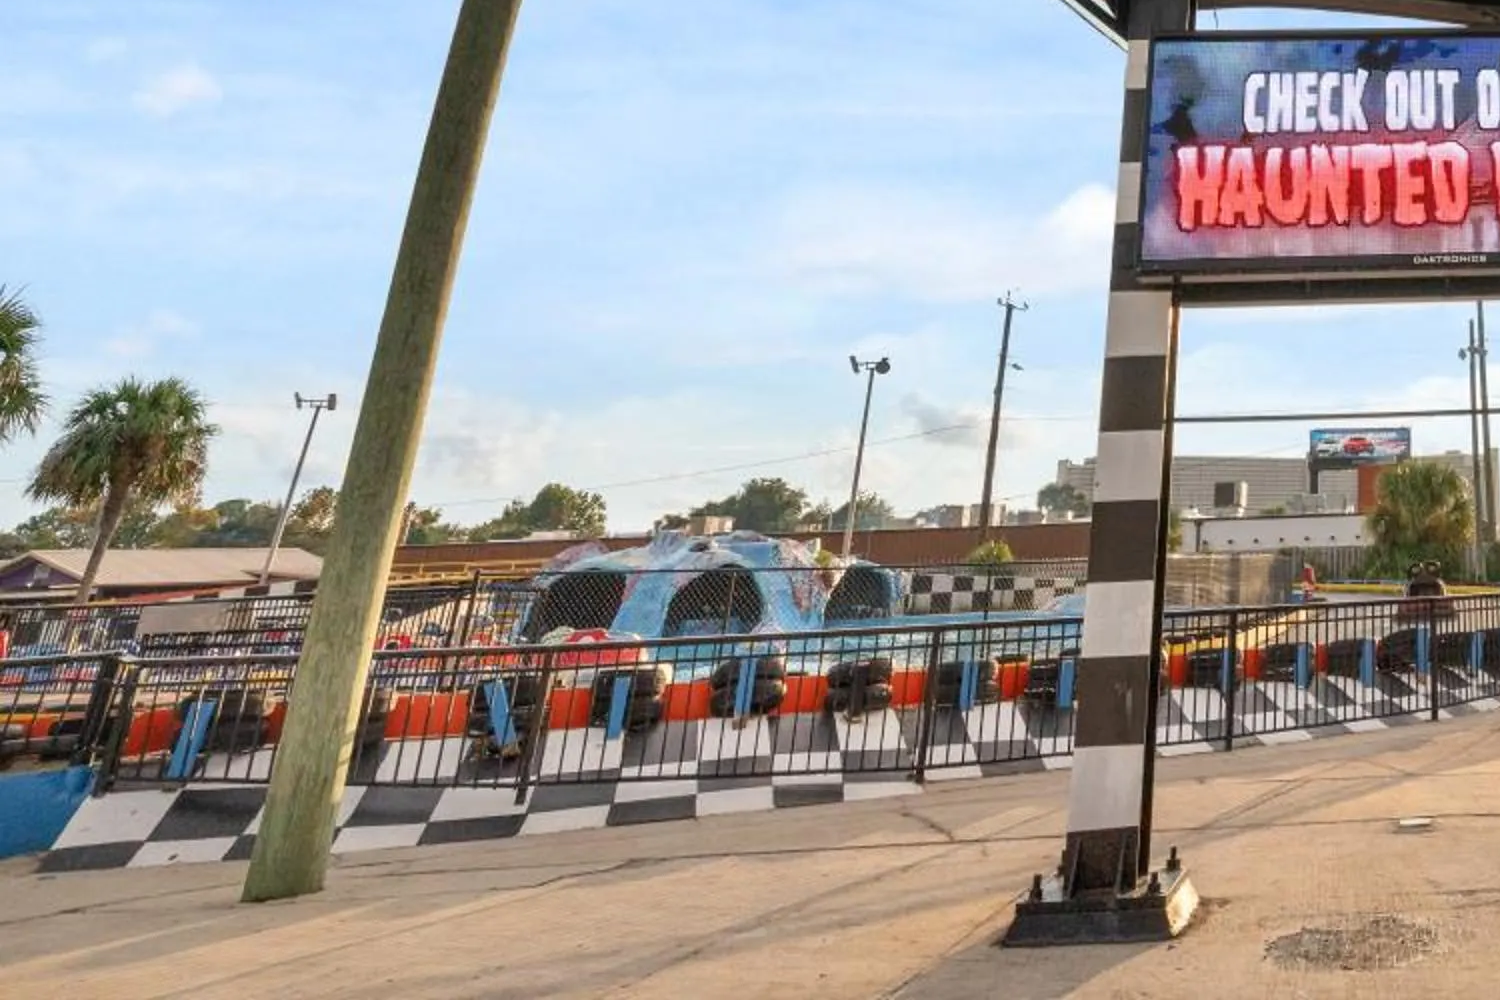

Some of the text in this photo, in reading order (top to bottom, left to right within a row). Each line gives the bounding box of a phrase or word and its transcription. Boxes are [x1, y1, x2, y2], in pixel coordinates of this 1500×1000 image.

[1243, 68, 1371, 134] CHECK
[1384, 68, 1460, 132] OUT
[1173, 138, 1471, 232] HAUNTED
